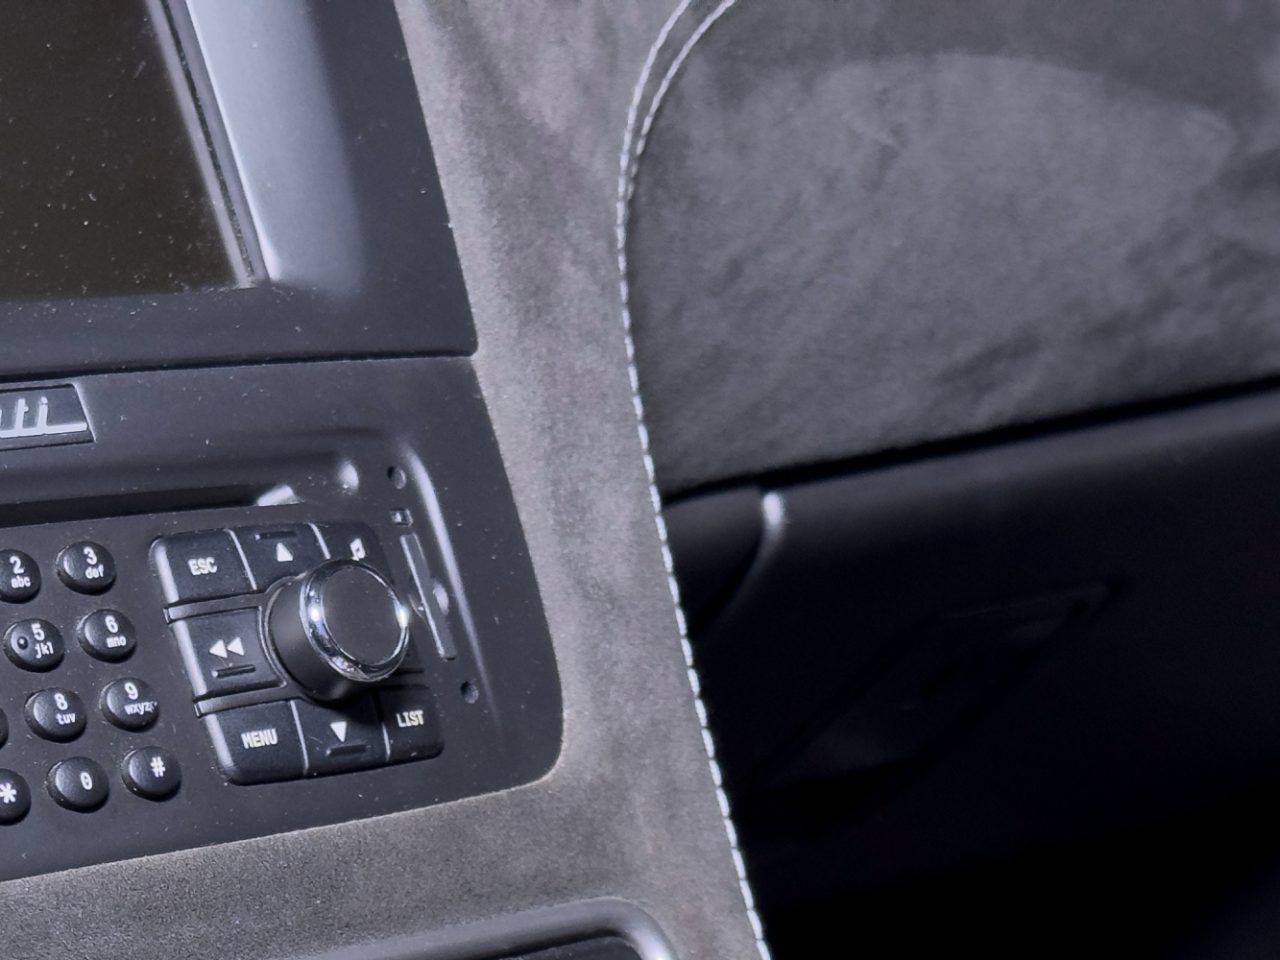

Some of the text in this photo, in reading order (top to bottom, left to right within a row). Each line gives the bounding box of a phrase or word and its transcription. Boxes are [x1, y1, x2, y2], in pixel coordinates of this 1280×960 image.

[83, 546, 98, 565] 3
[10, 556, 25, 574] 2
[188, 557, 217, 576] ESC
[31, 623, 45, 640] 5
[105, 615, 118, 633] 6
[124, 682, 138, 700] 9
[54, 693, 68, 710] 8
[396, 710, 424, 727] LIST
[240, 729, 278, 748] MENU
